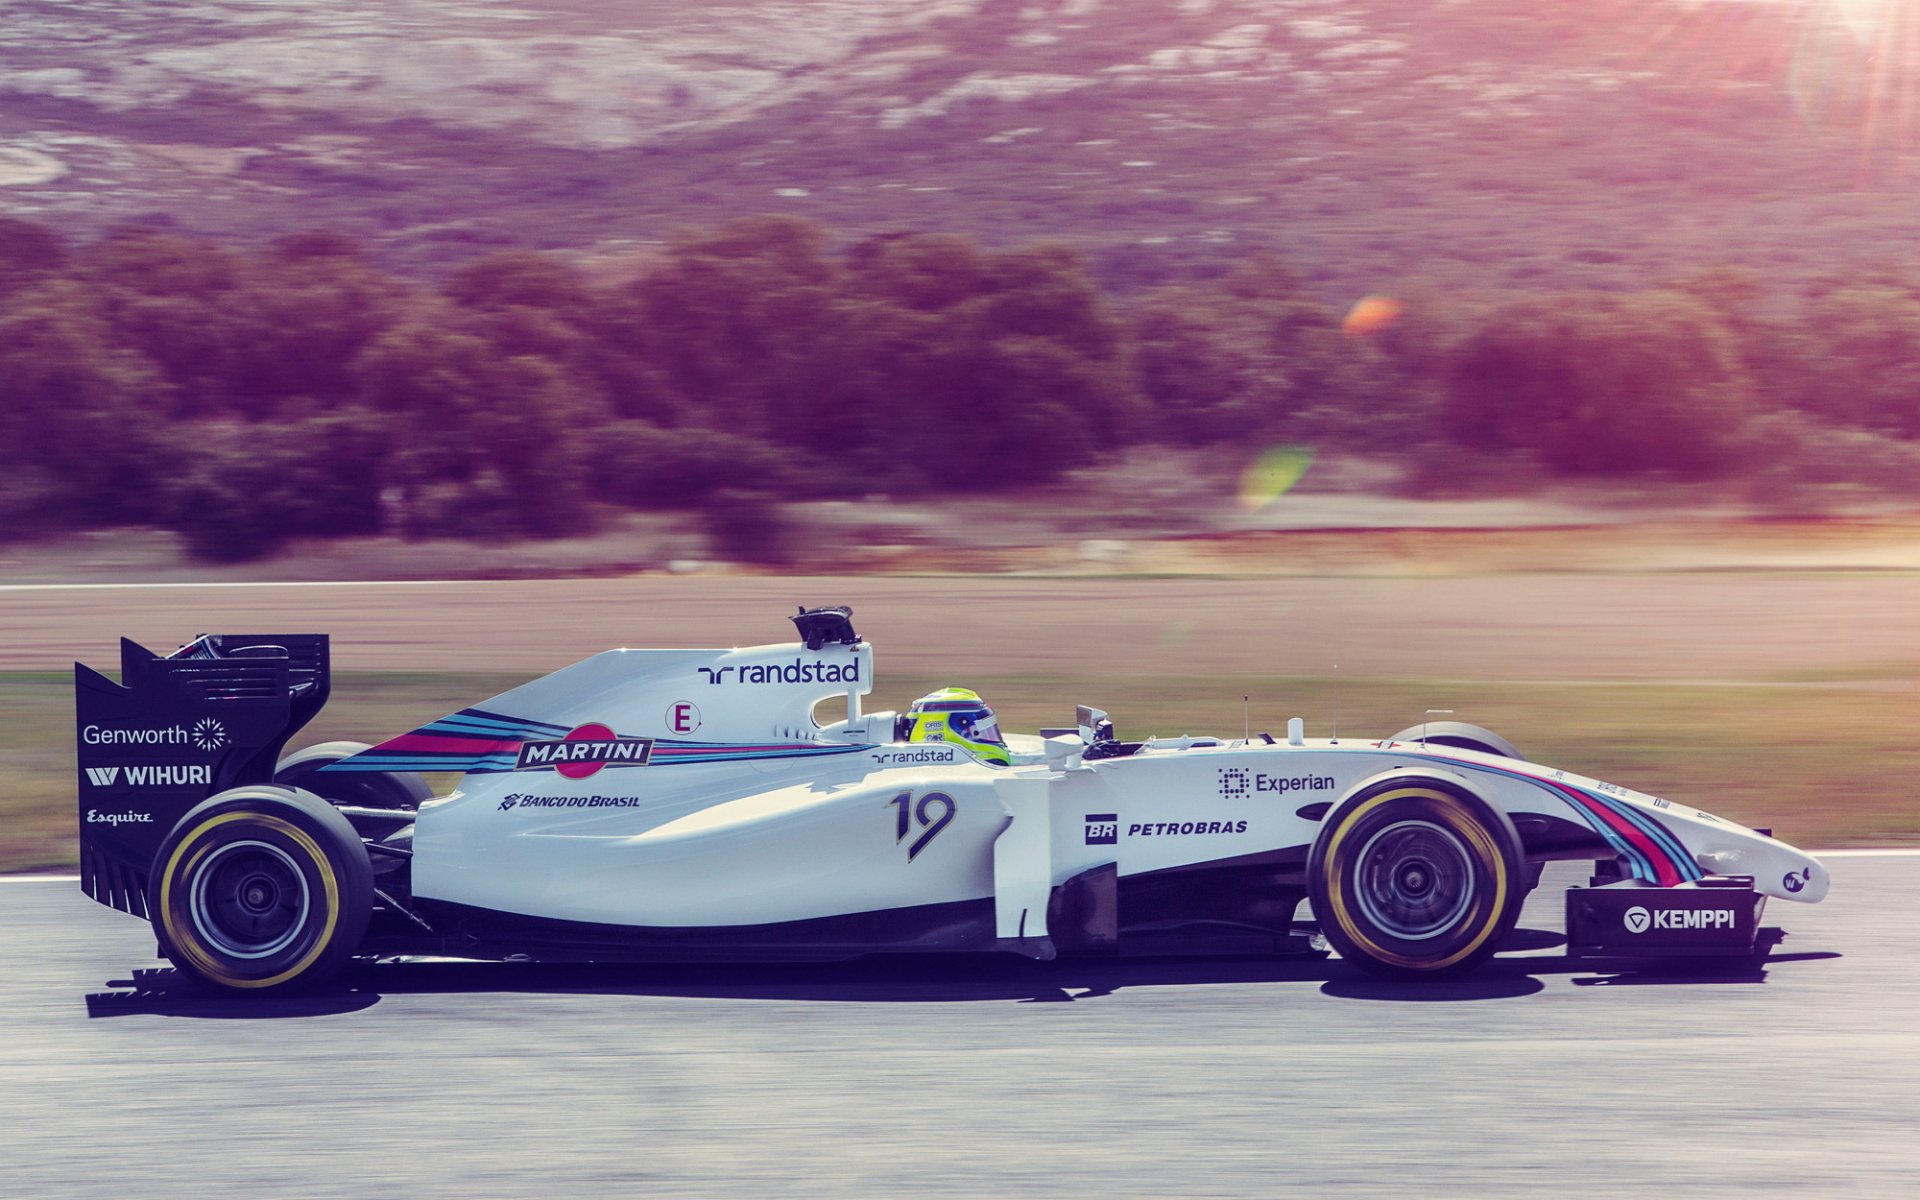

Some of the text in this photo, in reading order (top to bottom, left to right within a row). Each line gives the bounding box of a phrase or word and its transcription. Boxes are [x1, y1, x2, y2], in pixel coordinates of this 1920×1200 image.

[739, 657, 859, 683] randstad
[675, 704, 690, 732] E
[83, 725, 188, 744] Genworth
[525, 743, 644, 763] MARTINI
[893, 749, 954, 763] randstad
[124, 765, 211, 785] WIHURI
[1256, 773, 1335, 795] Experian
[519, 795, 567, 807] BANCO
[587, 795, 640, 807] BRASIL
[87, 809, 153, 827] Esquire
[886, 790, 958, 863] 19
[1087, 821, 1248, 838] BR PETROBRAS
[1654, 909, 1735, 929] KEMPPI
